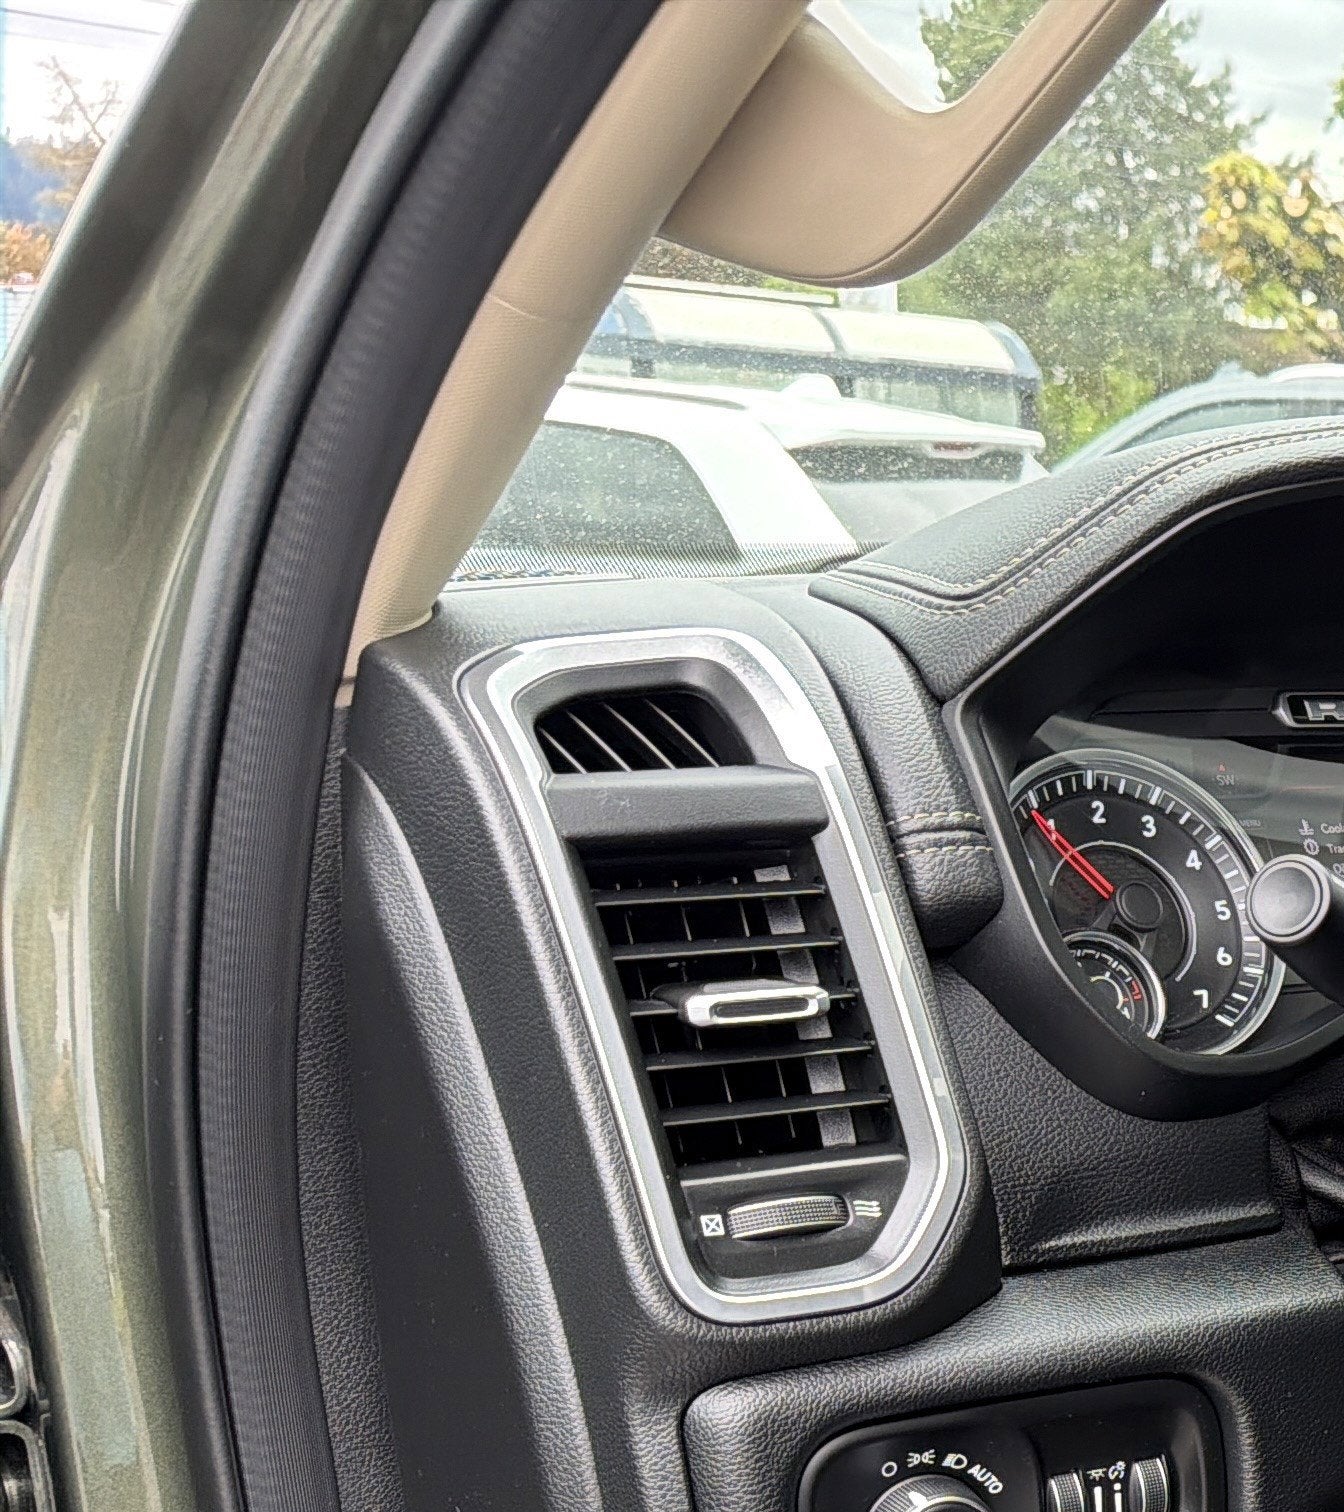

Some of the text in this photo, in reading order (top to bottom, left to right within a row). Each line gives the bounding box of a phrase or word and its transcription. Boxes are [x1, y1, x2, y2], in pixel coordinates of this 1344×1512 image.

[1216, 774, 1235, 786] SW
[1091, 801, 1107, 824] 2
[1141, 815, 1157, 837] 3
[1185, 849, 1203, 871] 4
[1215, 900, 1232, 921] 5
[1216, 946, 1233, 966] 6
[1193, 990, 1210, 1009] 7
[967, 1464, 1003, 1494] AUTO
